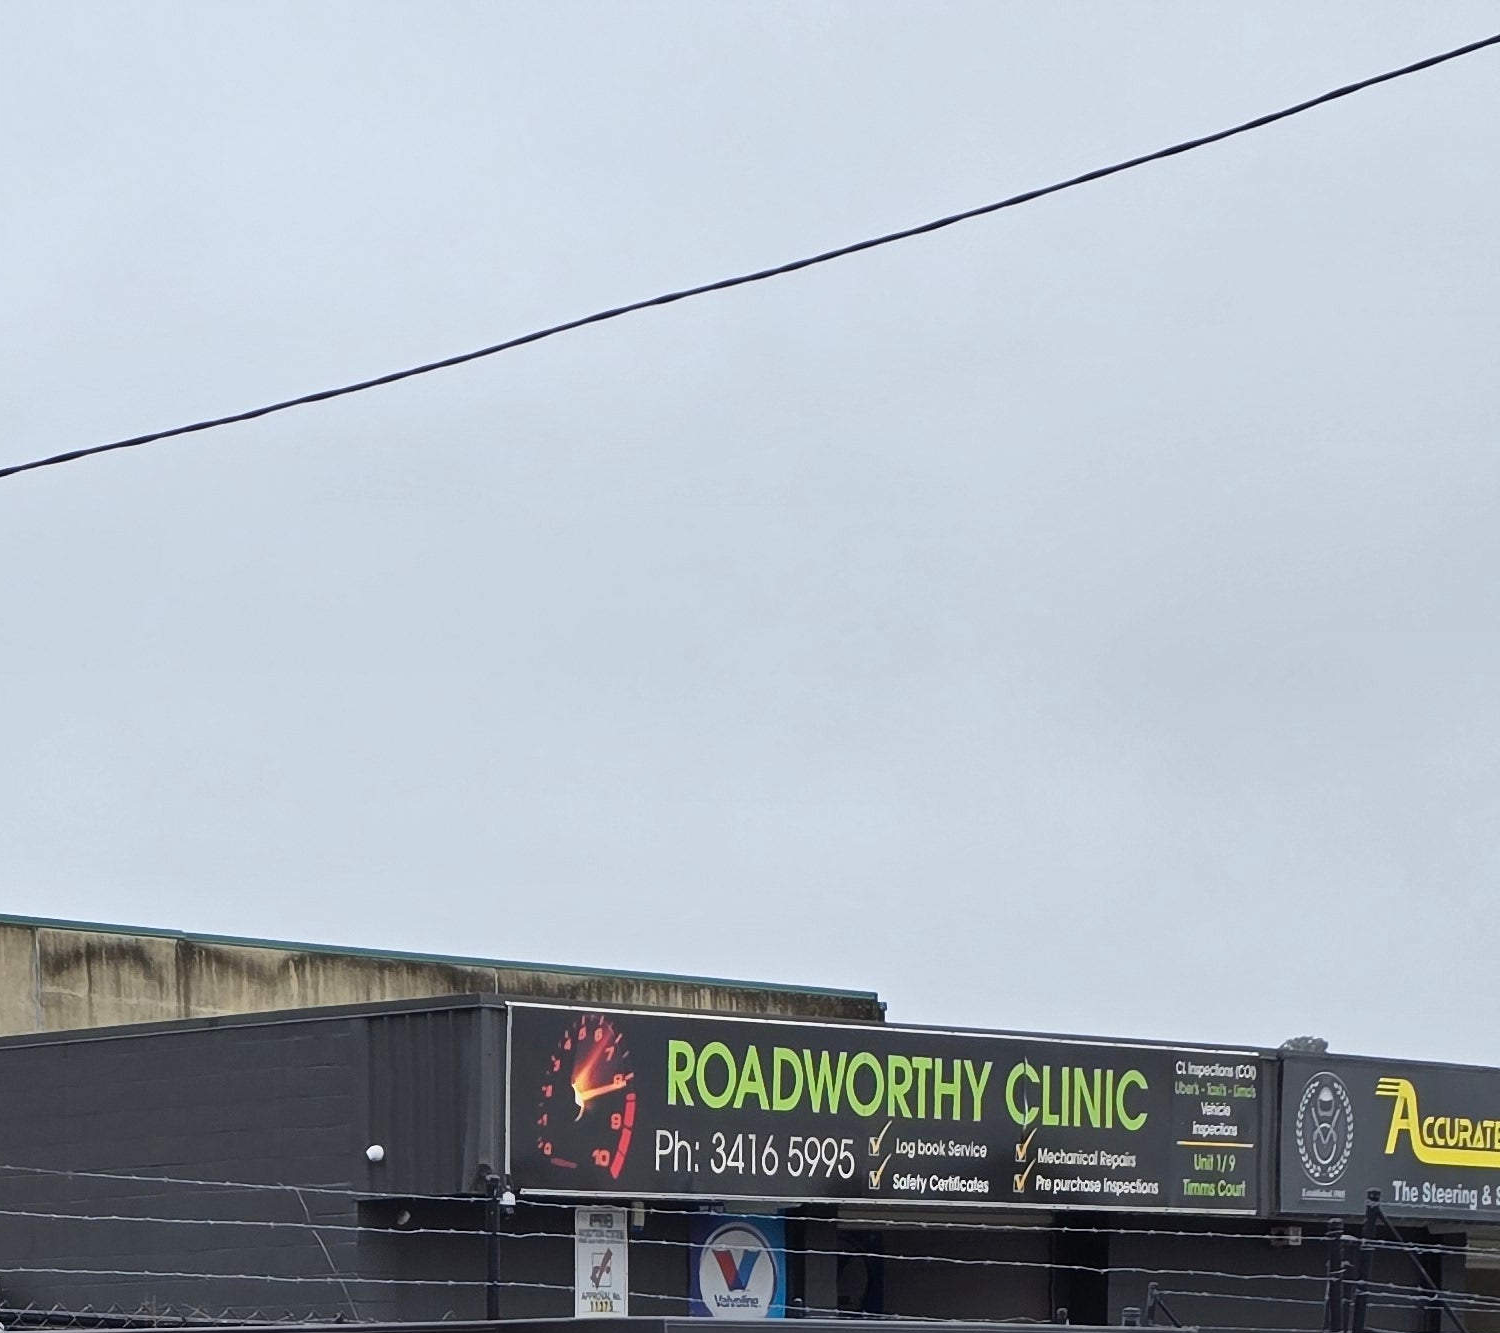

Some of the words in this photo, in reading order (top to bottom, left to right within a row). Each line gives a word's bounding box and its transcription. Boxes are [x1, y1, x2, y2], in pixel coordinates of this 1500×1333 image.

[667, 1039, 992, 1122] ROADWORTHY
[1005, 1062, 1149, 1131] CLINIC
[592, 1149, 610, 1167] 10
[654, 1129, 700, 1173] Ph:
[710, 1131, 779, 1177] 3416
[787, 1136, 855, 1180] 5995
[895, 1137, 916, 1159] Log
[917, 1138, 946, 1157] book
[948, 1140, 987, 1159] Service
[1037, 1147, 1098, 1166] Mechanical
[1100, 1150, 1137, 1169] Repairs
[1193, 1153, 1214, 1171] Unit
[892, 1174, 926, 1194] Safety
[929, 1174, 989, 1194] Certificates
[1035, 1174, 1052, 1190] Pre
[1053, 1175, 1100, 1195] purchase
[1103, 1176, 1159, 1195] Inspections
[1182, 1178, 1216, 1196] Timms
[1217, 1179, 1246, 1197] Court
[1392, 1180, 1419, 1203] The
[1422, 1181, 1478, 1210] Steering
[1481, 1185, 1492, 1206] &
